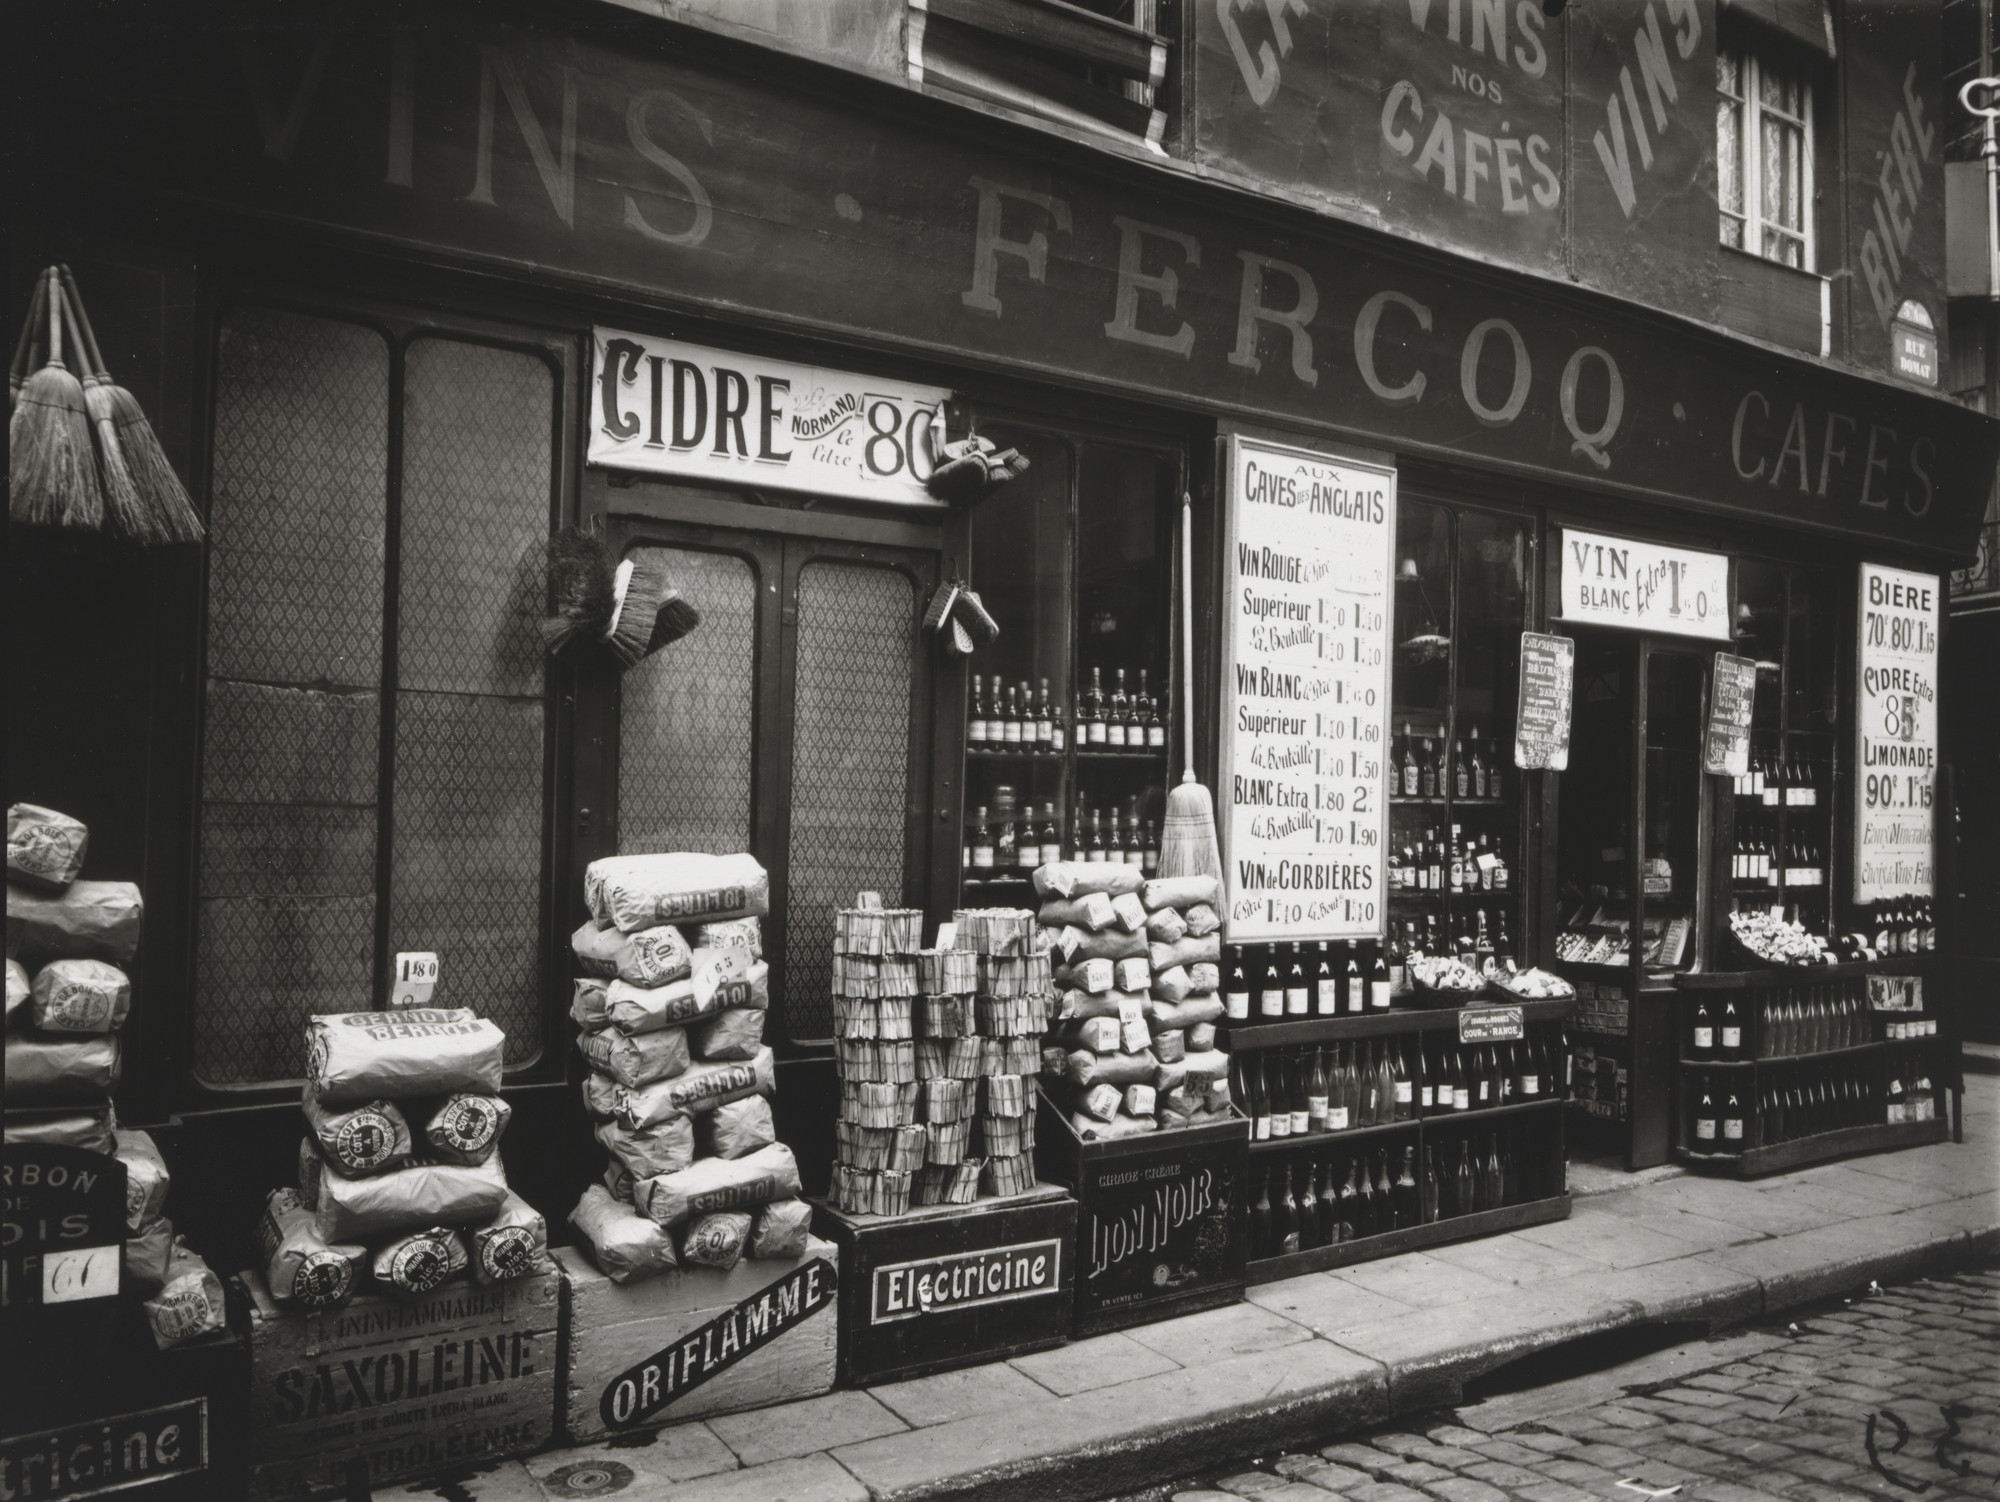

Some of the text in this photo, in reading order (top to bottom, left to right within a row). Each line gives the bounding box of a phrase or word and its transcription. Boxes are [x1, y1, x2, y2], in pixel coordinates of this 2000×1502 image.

[1451, 64, 1503, 105] NOS
[238, 16, 713, 248] VINS
[1380, 80, 1561, 217] CAFÉS
[961, 176, 1624, 473] FERCOQ
[1904, 338, 1927, 359] RUE
[599, 338, 793, 466] CIDRE
[791, 392, 857, 436] NORMAND
[1245, 460, 1297, 509] CAVES
[1309, 482, 1385, 525] ANGLAIS
[1295, 465, 1341, 483] AUX
[1239, 541, 1260, 578] VIN
[1261, 545, 1302, 584] ROUGE
[1568, 540, 1629, 581] VIN
[1580, 559, 1667, 614] BLANC Extra
[1236, 663, 1257, 696] VIN
[1261, 666, 1302, 700] BLANC
[1864, 666, 1911, 698] CIDRE
[1864, 736, 1934, 768] LIMONADE
[1234, 774, 1274, 806] BLANC
[1276, 782, 1309, 809] Extra
[1239, 859, 1265, 890] VIN
[1266, 869, 1278, 890] de
[1489, 1025, 1518, 1036] RANCE
[886, 1252, 1047, 1312] Electricine
[612, 1264, 821, 1422] ORIFLAMME
[361, 1416, 377, 1432] DE
[432, 1400, 468, 1419] EXTRA
[472, 1391, 509, 1410] BLANC
